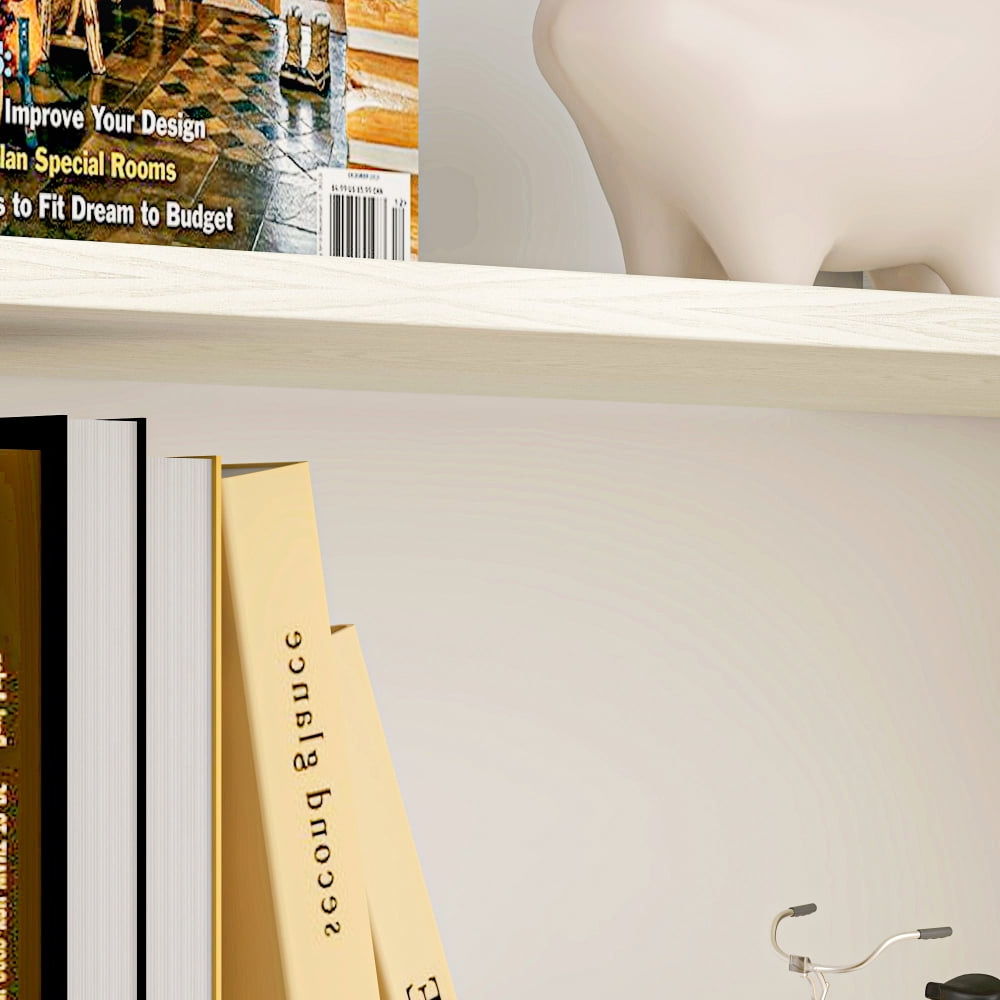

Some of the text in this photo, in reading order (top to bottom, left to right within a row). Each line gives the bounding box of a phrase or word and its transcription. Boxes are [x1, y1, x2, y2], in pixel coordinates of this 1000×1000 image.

[5, 98, 84, 130] Improve
[91, 104, 135, 133] Your
[141, 109, 206, 143] Design
[35, 146, 104, 179] Special
[111, 152, 177, 182] Rooms
[12, 192, 33, 218] to
[39, 193, 65, 221] Fit
[71, 194, 134, 225] Dream
[141, 201, 160, 227] to
[166, 201, 234, 235] Budget
